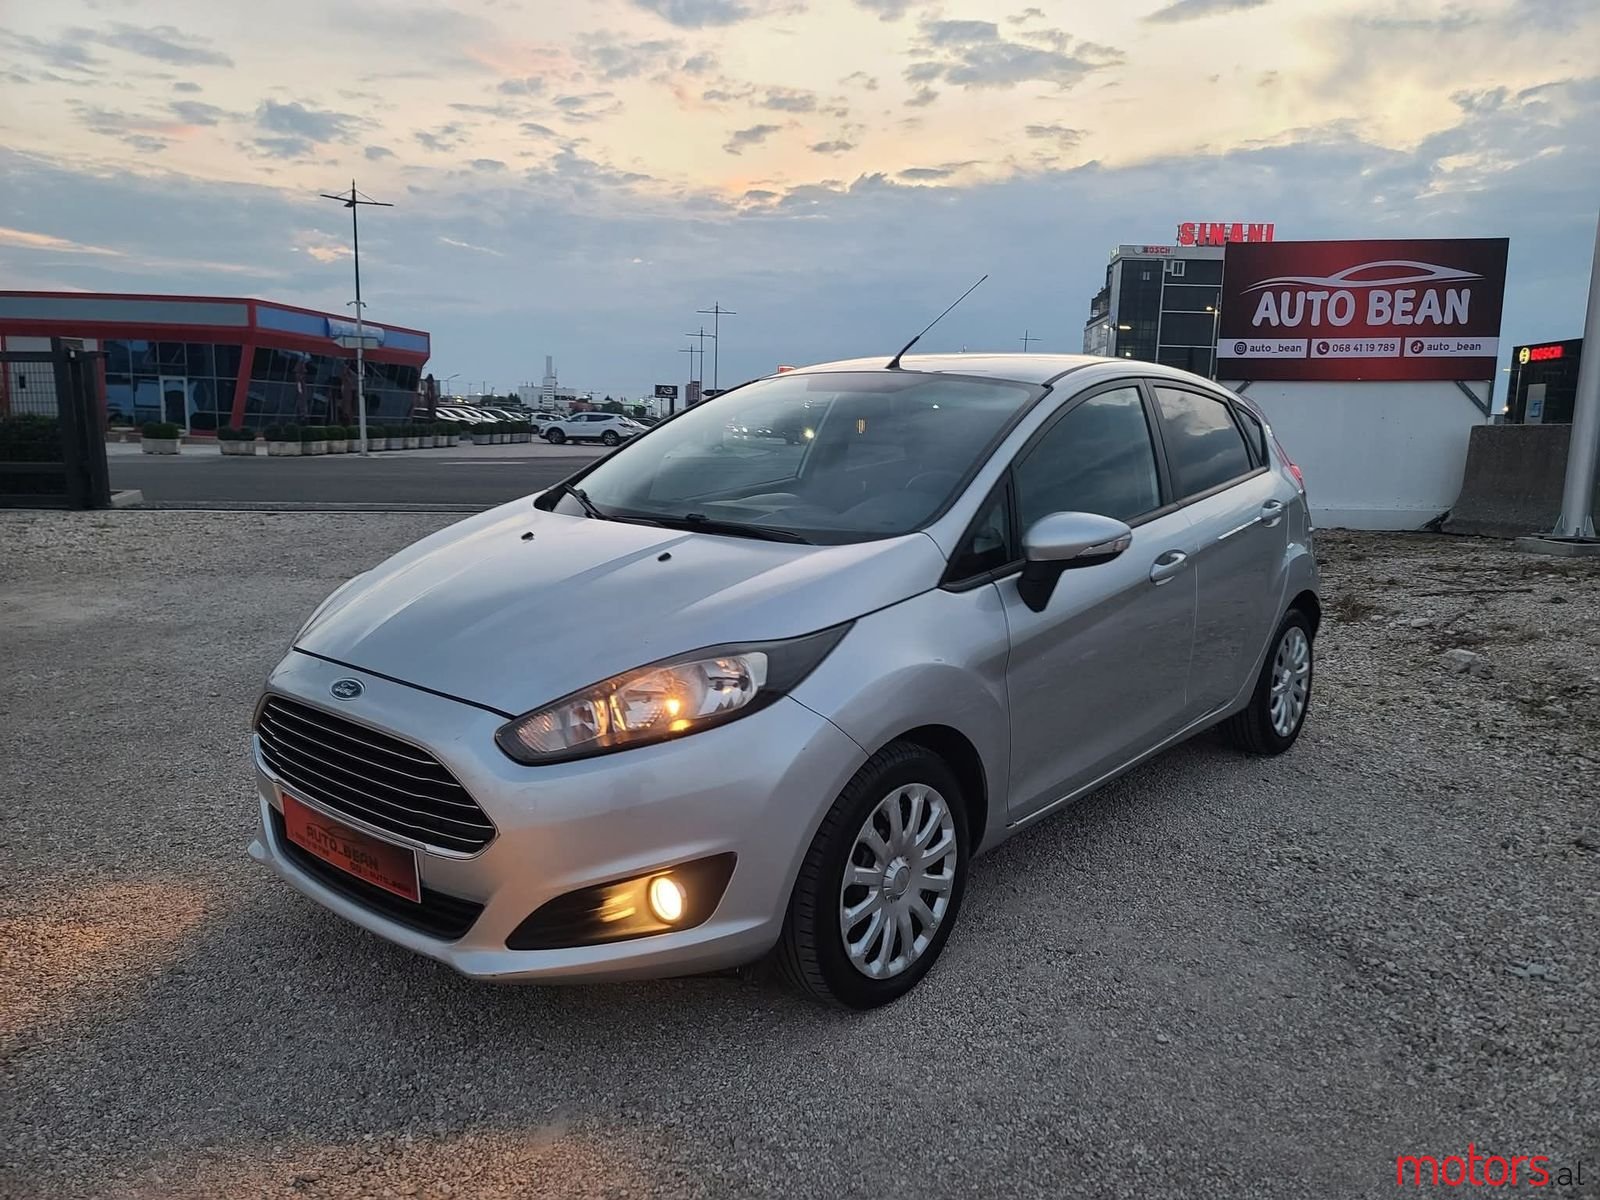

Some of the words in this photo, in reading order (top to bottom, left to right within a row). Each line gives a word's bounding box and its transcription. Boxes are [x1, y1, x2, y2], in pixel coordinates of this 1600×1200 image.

[1180, 223, 1274, 245] SINANI
[1252, 290, 1355, 326] AUTO
[1366, 288, 1470, 326] BEAN
[1250, 344, 1302, 354] auto_bean
[1332, 344, 1350, 353] 068
[1353, 344, 1362, 352] 41
[1365, 343, 1375, 352] 19
[1377, 343, 1396, 352] 789
[1427, 342, 1481, 353] auto_bean
